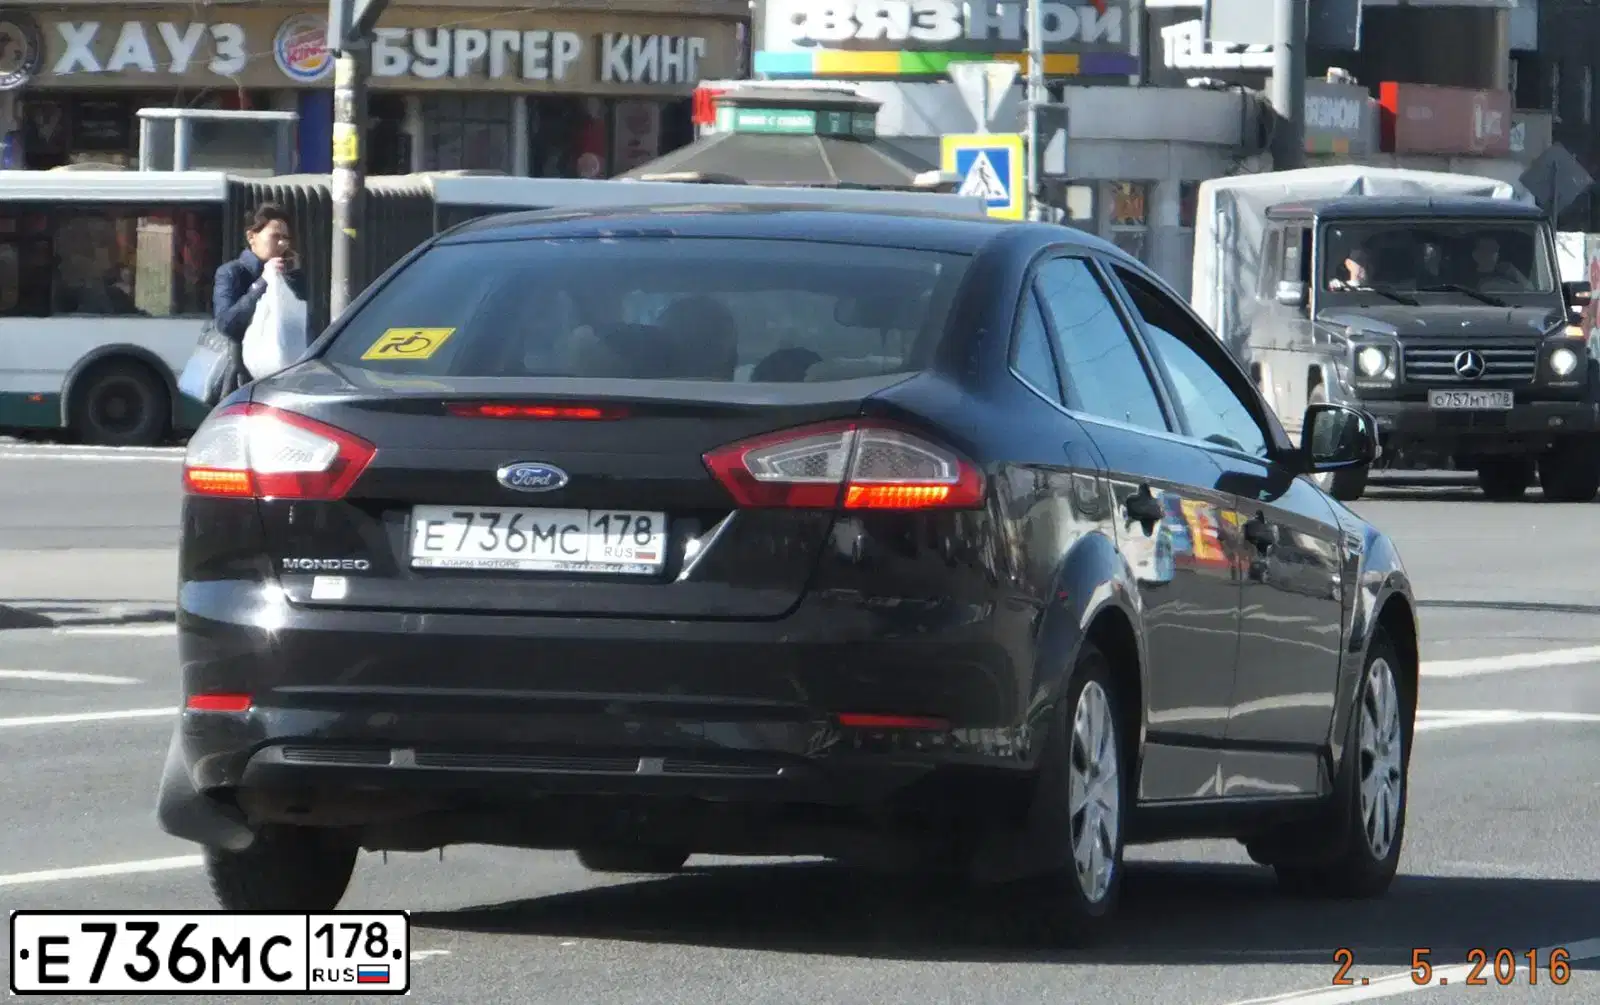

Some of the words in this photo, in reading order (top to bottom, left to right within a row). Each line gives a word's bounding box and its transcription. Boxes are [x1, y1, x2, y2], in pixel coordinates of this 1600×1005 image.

[53, 20, 247, 76] ХАУЗ
[371, 27, 583, 80] БУРГЕР
[602, 32, 706, 83] КИНГ
[511, 468, 553, 486] Ford
[424, 512, 581, 555] Е736МС
[594, 514, 652, 547] 178
[282, 558, 370, 570] MONDEO
[604, 547, 634, 560] RUS
